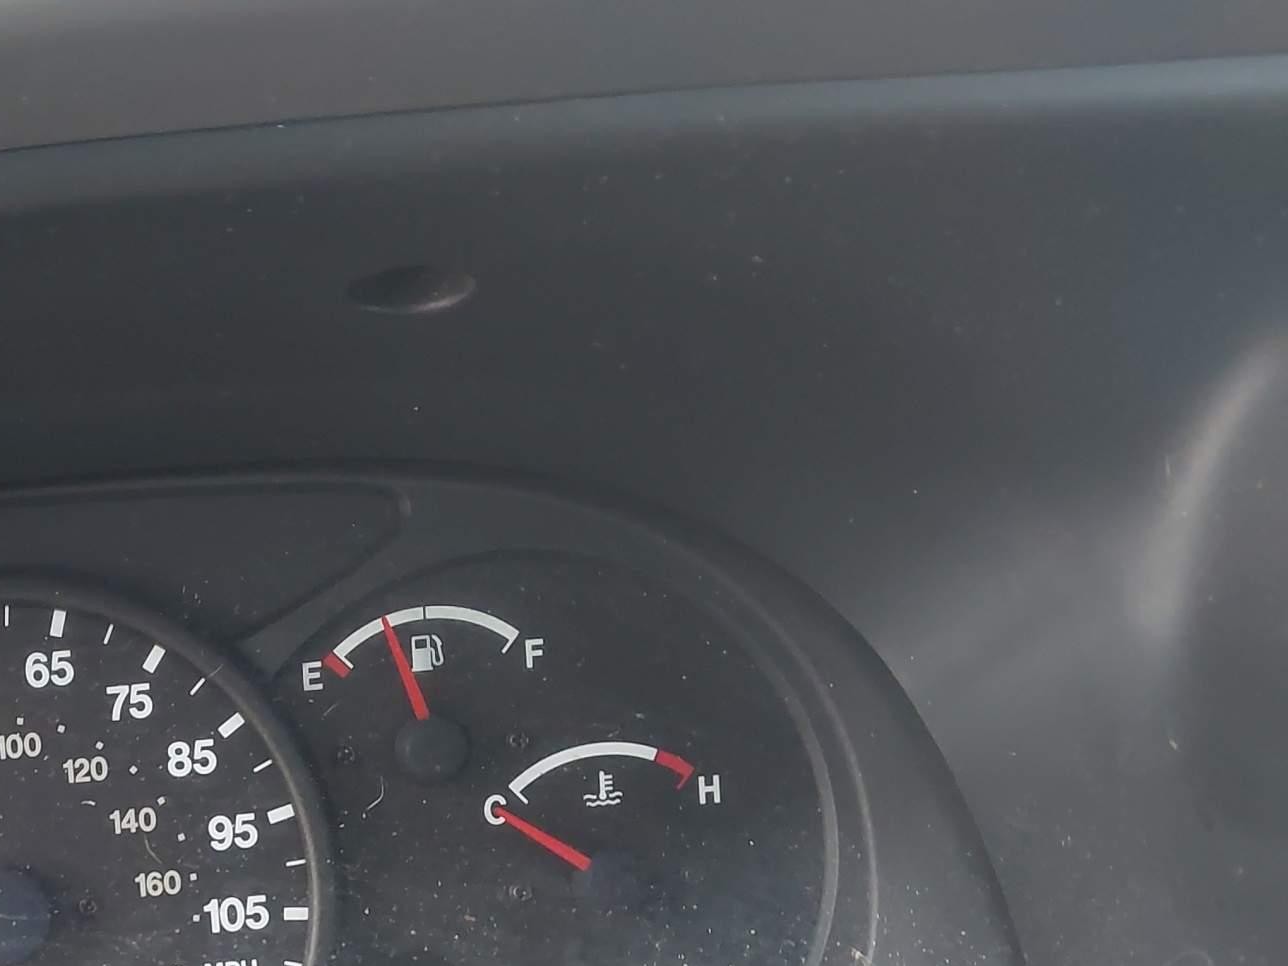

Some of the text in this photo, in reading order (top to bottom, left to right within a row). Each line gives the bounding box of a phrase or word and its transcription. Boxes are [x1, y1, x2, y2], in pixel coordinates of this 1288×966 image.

[525, 639, 543, 668] F
[26, 650, 74, 688] 65
[303, 661, 323, 690] E
[107, 683, 152, 721] 75
[63, 757, 108, 783] 120
[168, 739, 216, 777] 85
[698, 775, 720, 804] H
[110, 808, 156, 834] 140
[484, 795, 506, 825] C
[208, 813, 257, 850] 95
[135, 870, 181, 897] 160
[204, 895, 269, 933] 105
